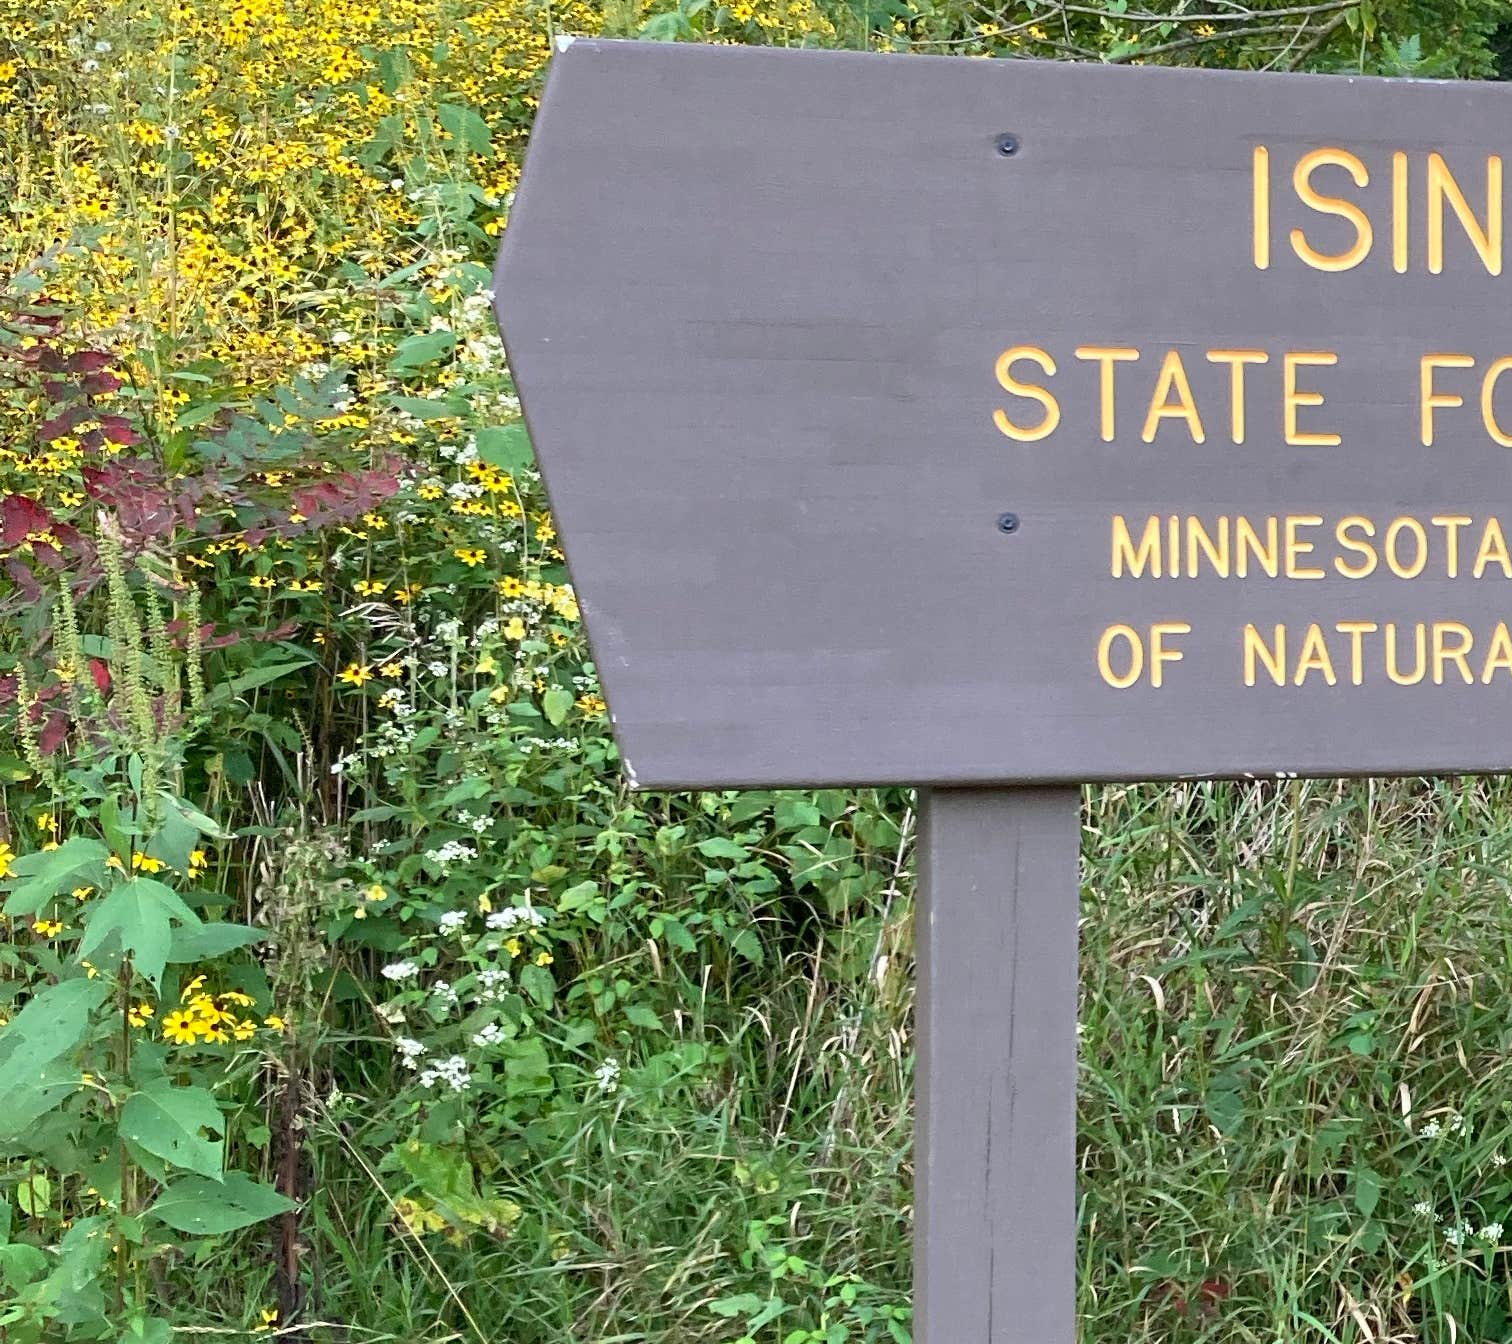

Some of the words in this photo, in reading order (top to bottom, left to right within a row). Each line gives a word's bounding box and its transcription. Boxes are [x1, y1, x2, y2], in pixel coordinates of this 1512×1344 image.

[994, 344, 1341, 446] STATE
[1110, 514, 1512, 577] MINNESOTA
[1097, 621, 1190, 686] OF
